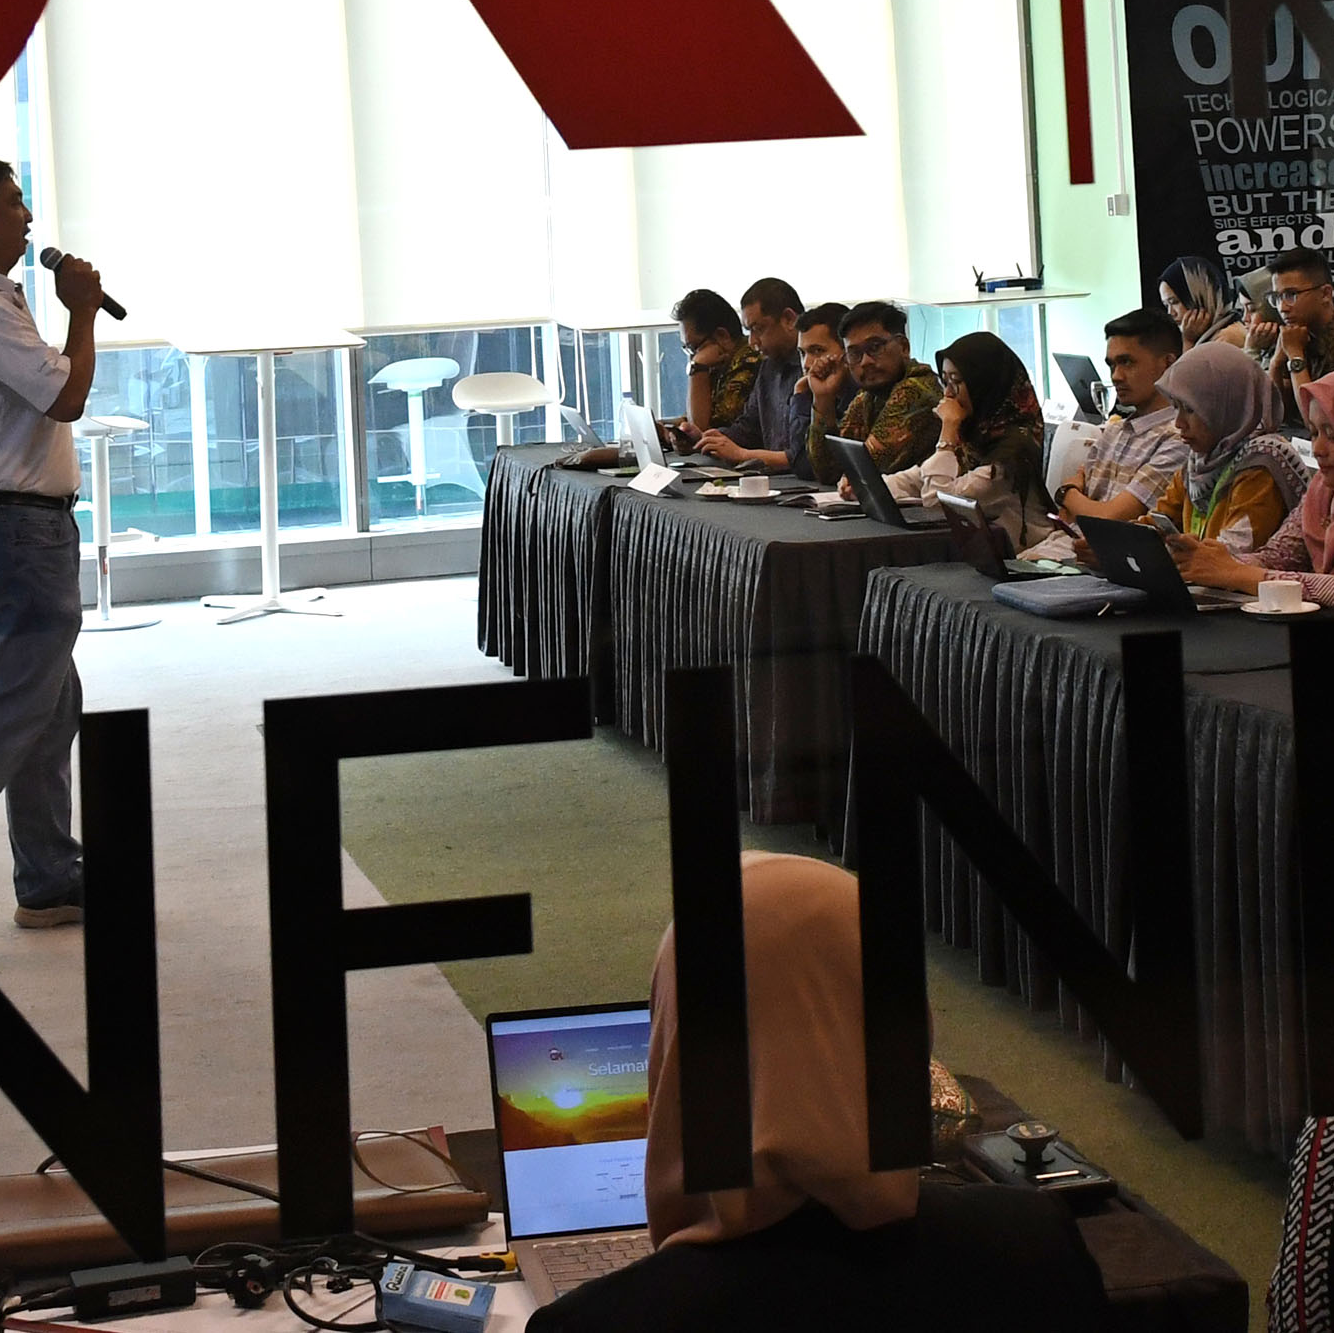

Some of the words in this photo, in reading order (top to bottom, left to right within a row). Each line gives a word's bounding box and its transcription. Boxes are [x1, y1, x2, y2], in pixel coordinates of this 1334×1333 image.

[1207, 192, 1274, 217] BUT
[1213, 217, 1247, 230] SIDE
[1250, 213, 1314, 228] EFFECTS
